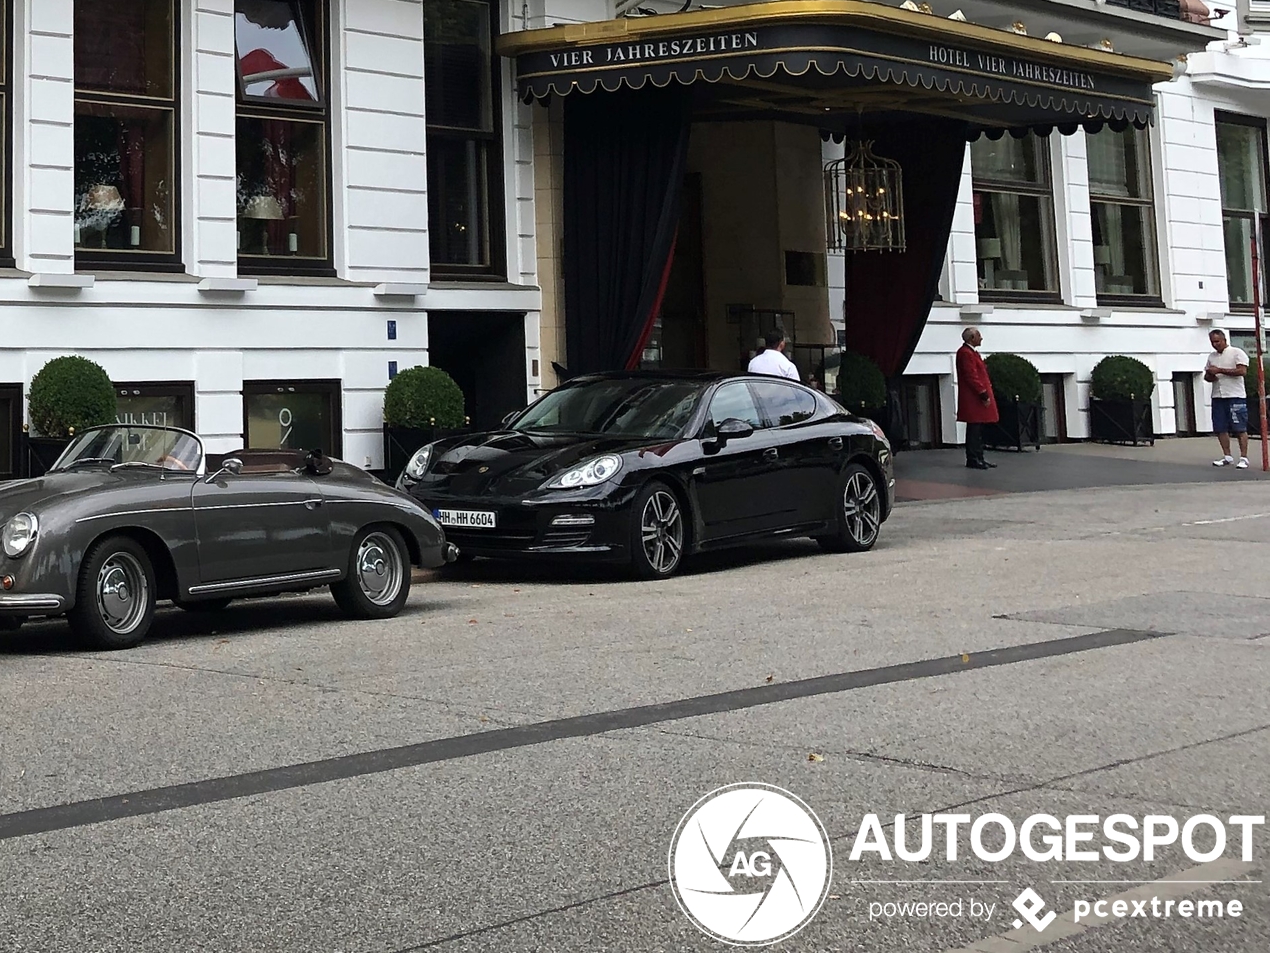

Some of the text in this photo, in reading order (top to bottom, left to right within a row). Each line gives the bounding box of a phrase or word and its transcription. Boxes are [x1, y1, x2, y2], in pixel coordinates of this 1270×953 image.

[550, 32, 758, 68] VIER JAHRESZEITEN
[930, 45, 1096, 90] HOTEL VIER JAHRESZEITEN
[279, 408, 292, 445] 9
[456, 512, 468, 524] HH
[470, 513, 493, 526] 6604
